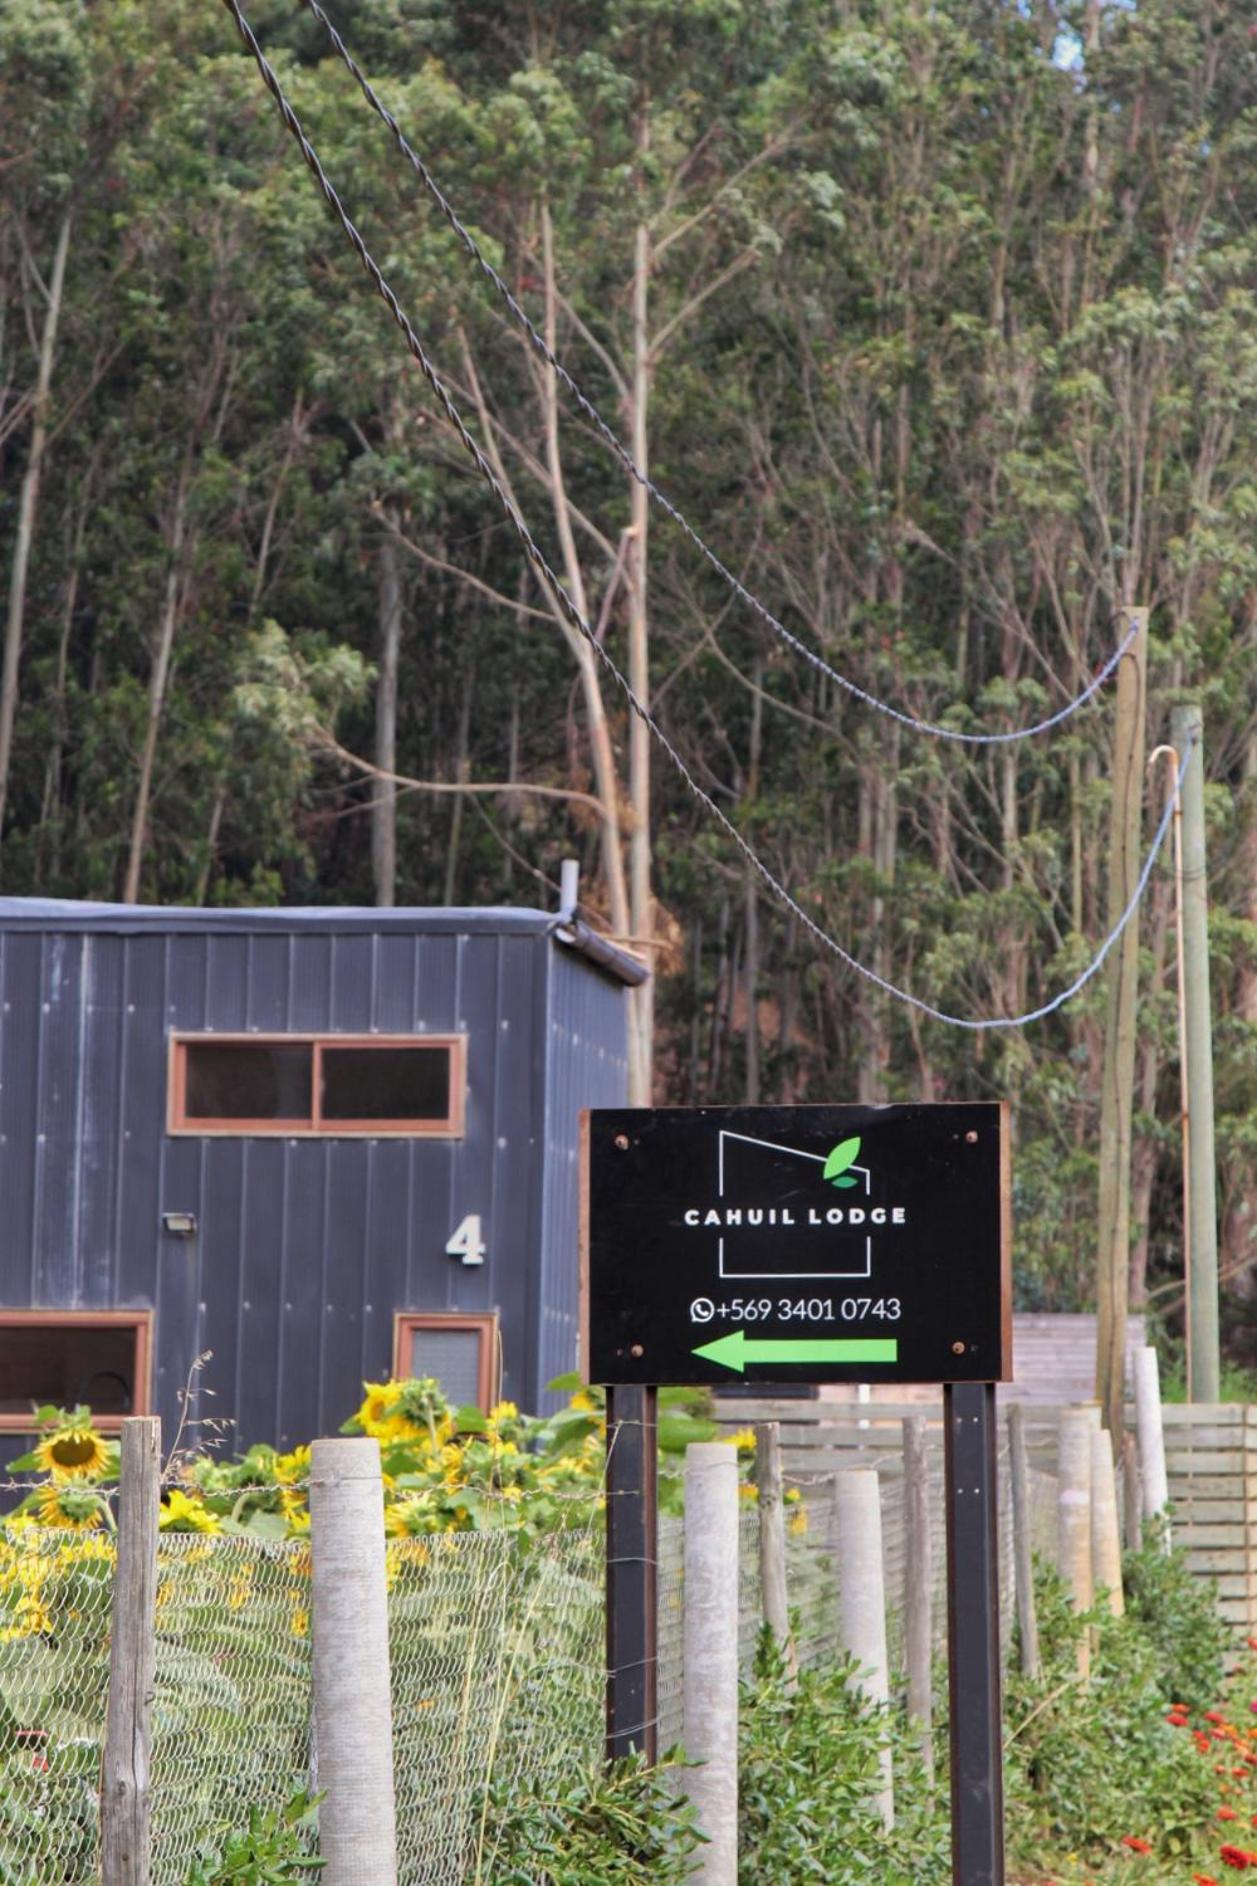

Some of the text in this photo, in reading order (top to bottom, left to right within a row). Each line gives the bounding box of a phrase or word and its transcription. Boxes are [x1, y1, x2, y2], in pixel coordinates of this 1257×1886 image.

[684, 1207, 906, 1226] CAHUIL LODGE
[445, 1214, 486, 1265] 4
[716, 1298, 901, 1321] +569 3401 0743
